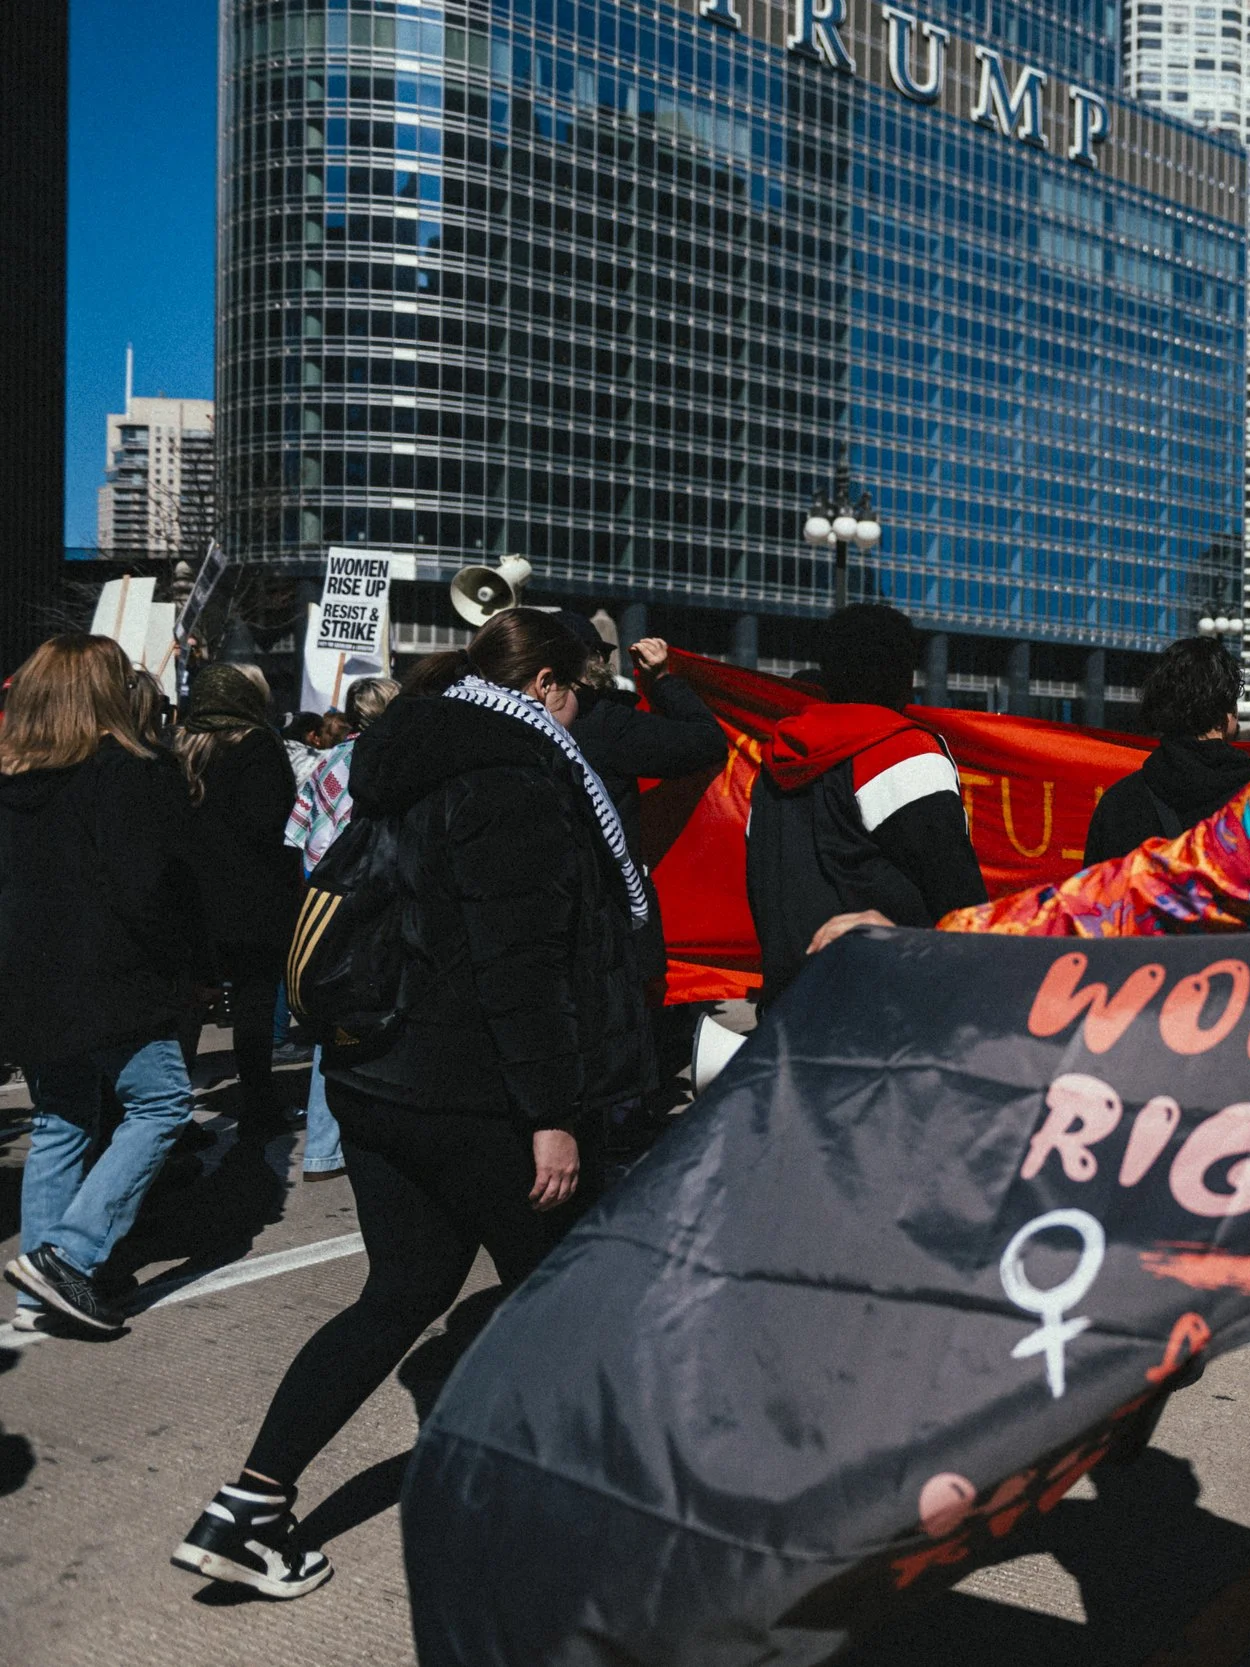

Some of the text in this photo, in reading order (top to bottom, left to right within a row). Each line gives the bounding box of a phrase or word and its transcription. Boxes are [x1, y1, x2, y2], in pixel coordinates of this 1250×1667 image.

[330, 557, 389, 578] WOMEN
[327, 576, 386, 598] RISE UP
[323, 603, 379, 622] RESIST &
[320, 619, 377, 641] STRIKE
